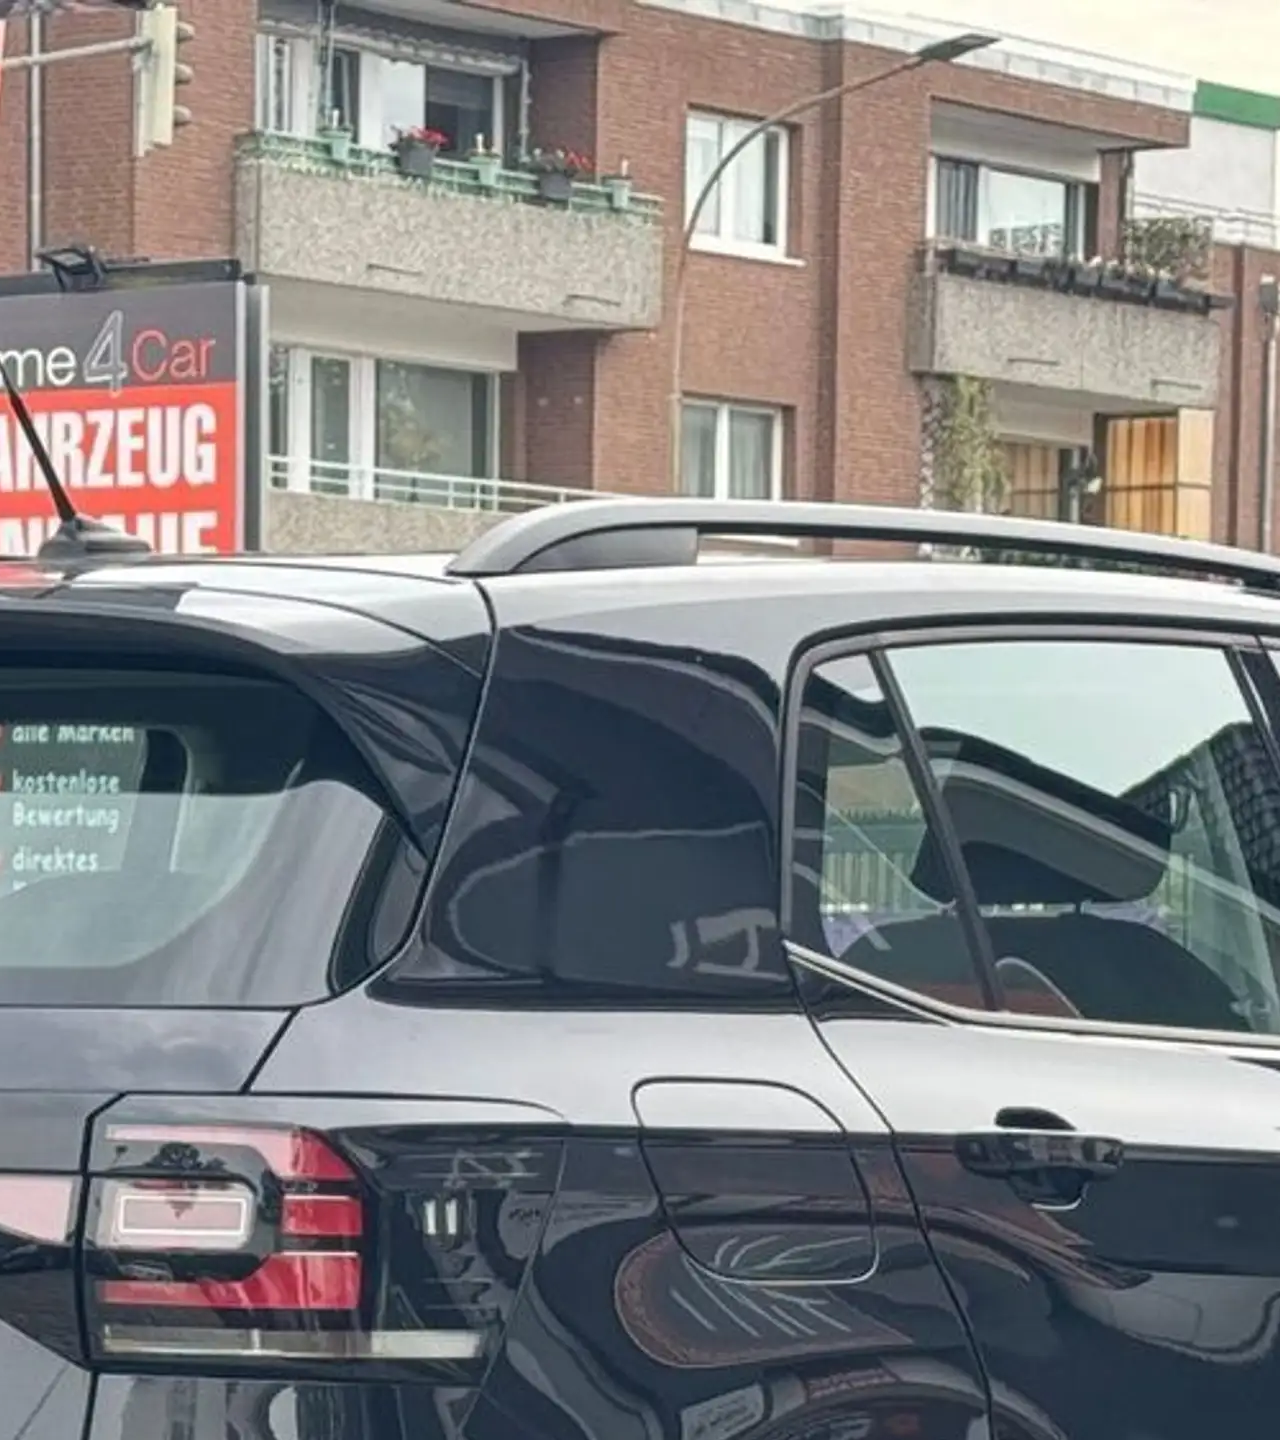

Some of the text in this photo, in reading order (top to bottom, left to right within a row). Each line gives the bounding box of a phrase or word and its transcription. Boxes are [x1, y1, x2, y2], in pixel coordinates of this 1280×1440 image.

[12, 768, 121, 795] kostenlose
[12, 801, 120, 834] Bewertung
[11, 846, 100, 873] direktes
